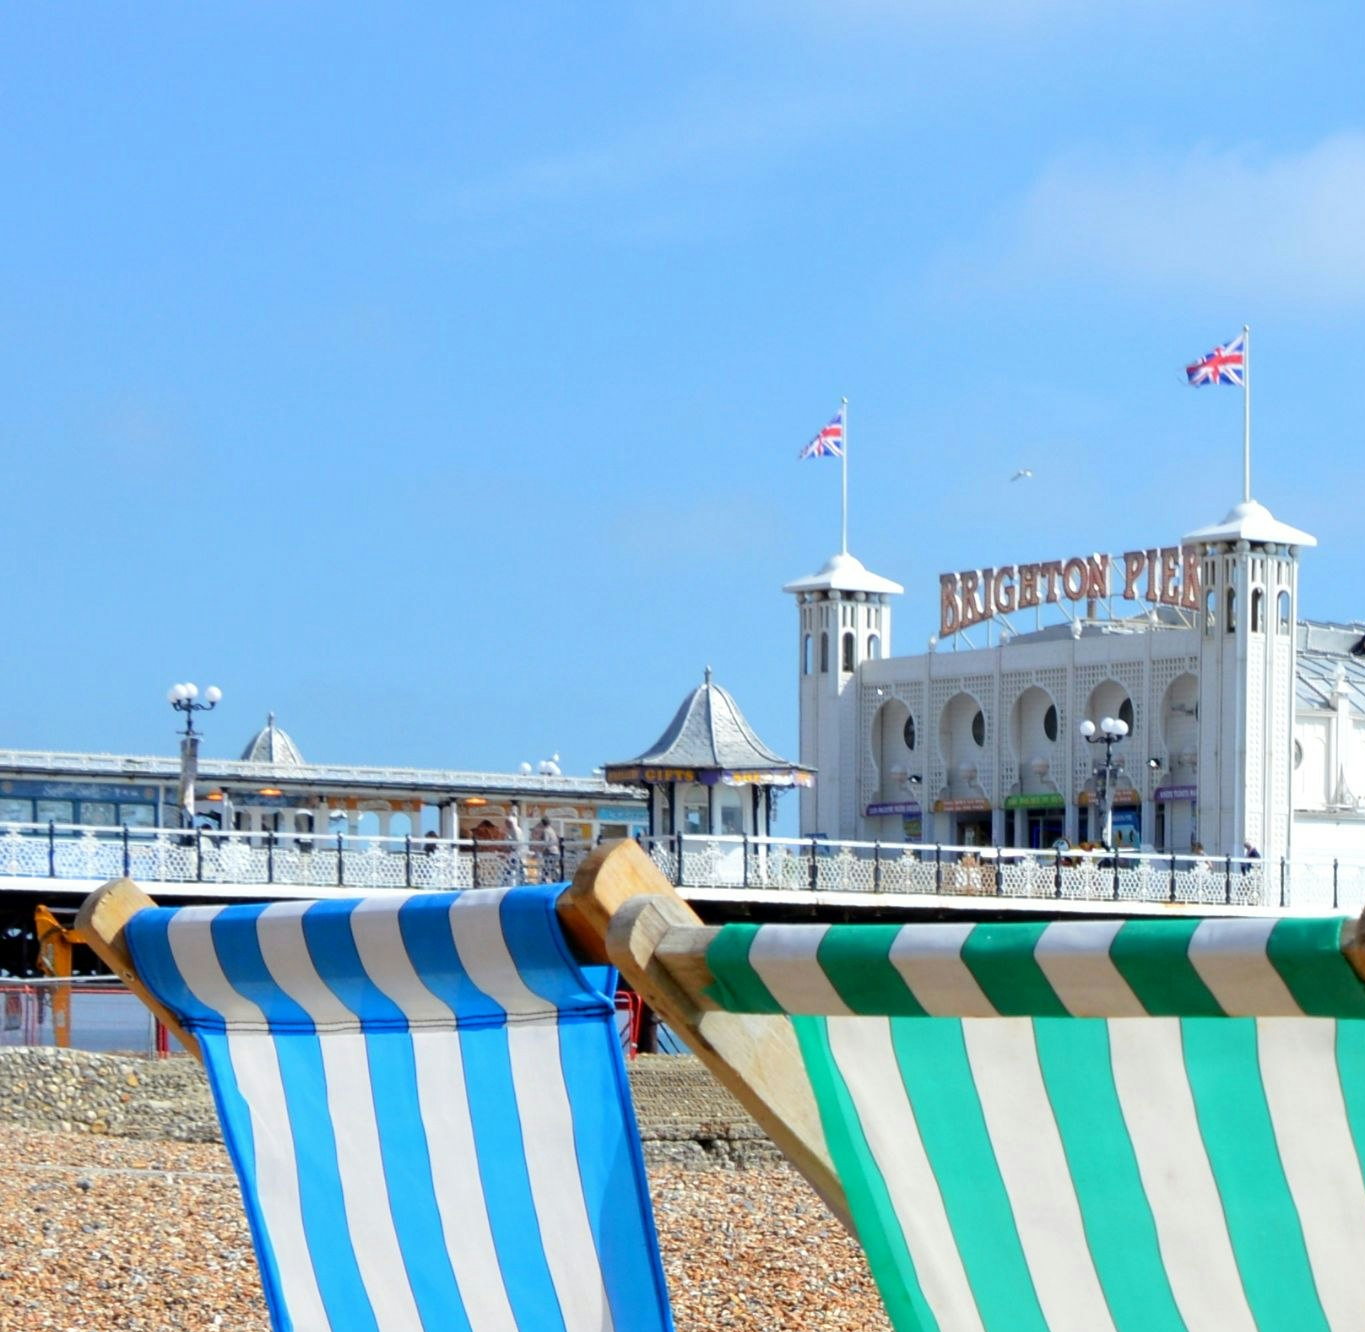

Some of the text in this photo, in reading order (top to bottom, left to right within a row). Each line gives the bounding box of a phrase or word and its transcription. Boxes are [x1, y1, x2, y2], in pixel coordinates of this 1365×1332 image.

[939, 546, 1201, 638] BRIGHTON PIER
[644, 769, 695, 782] GIFTS
